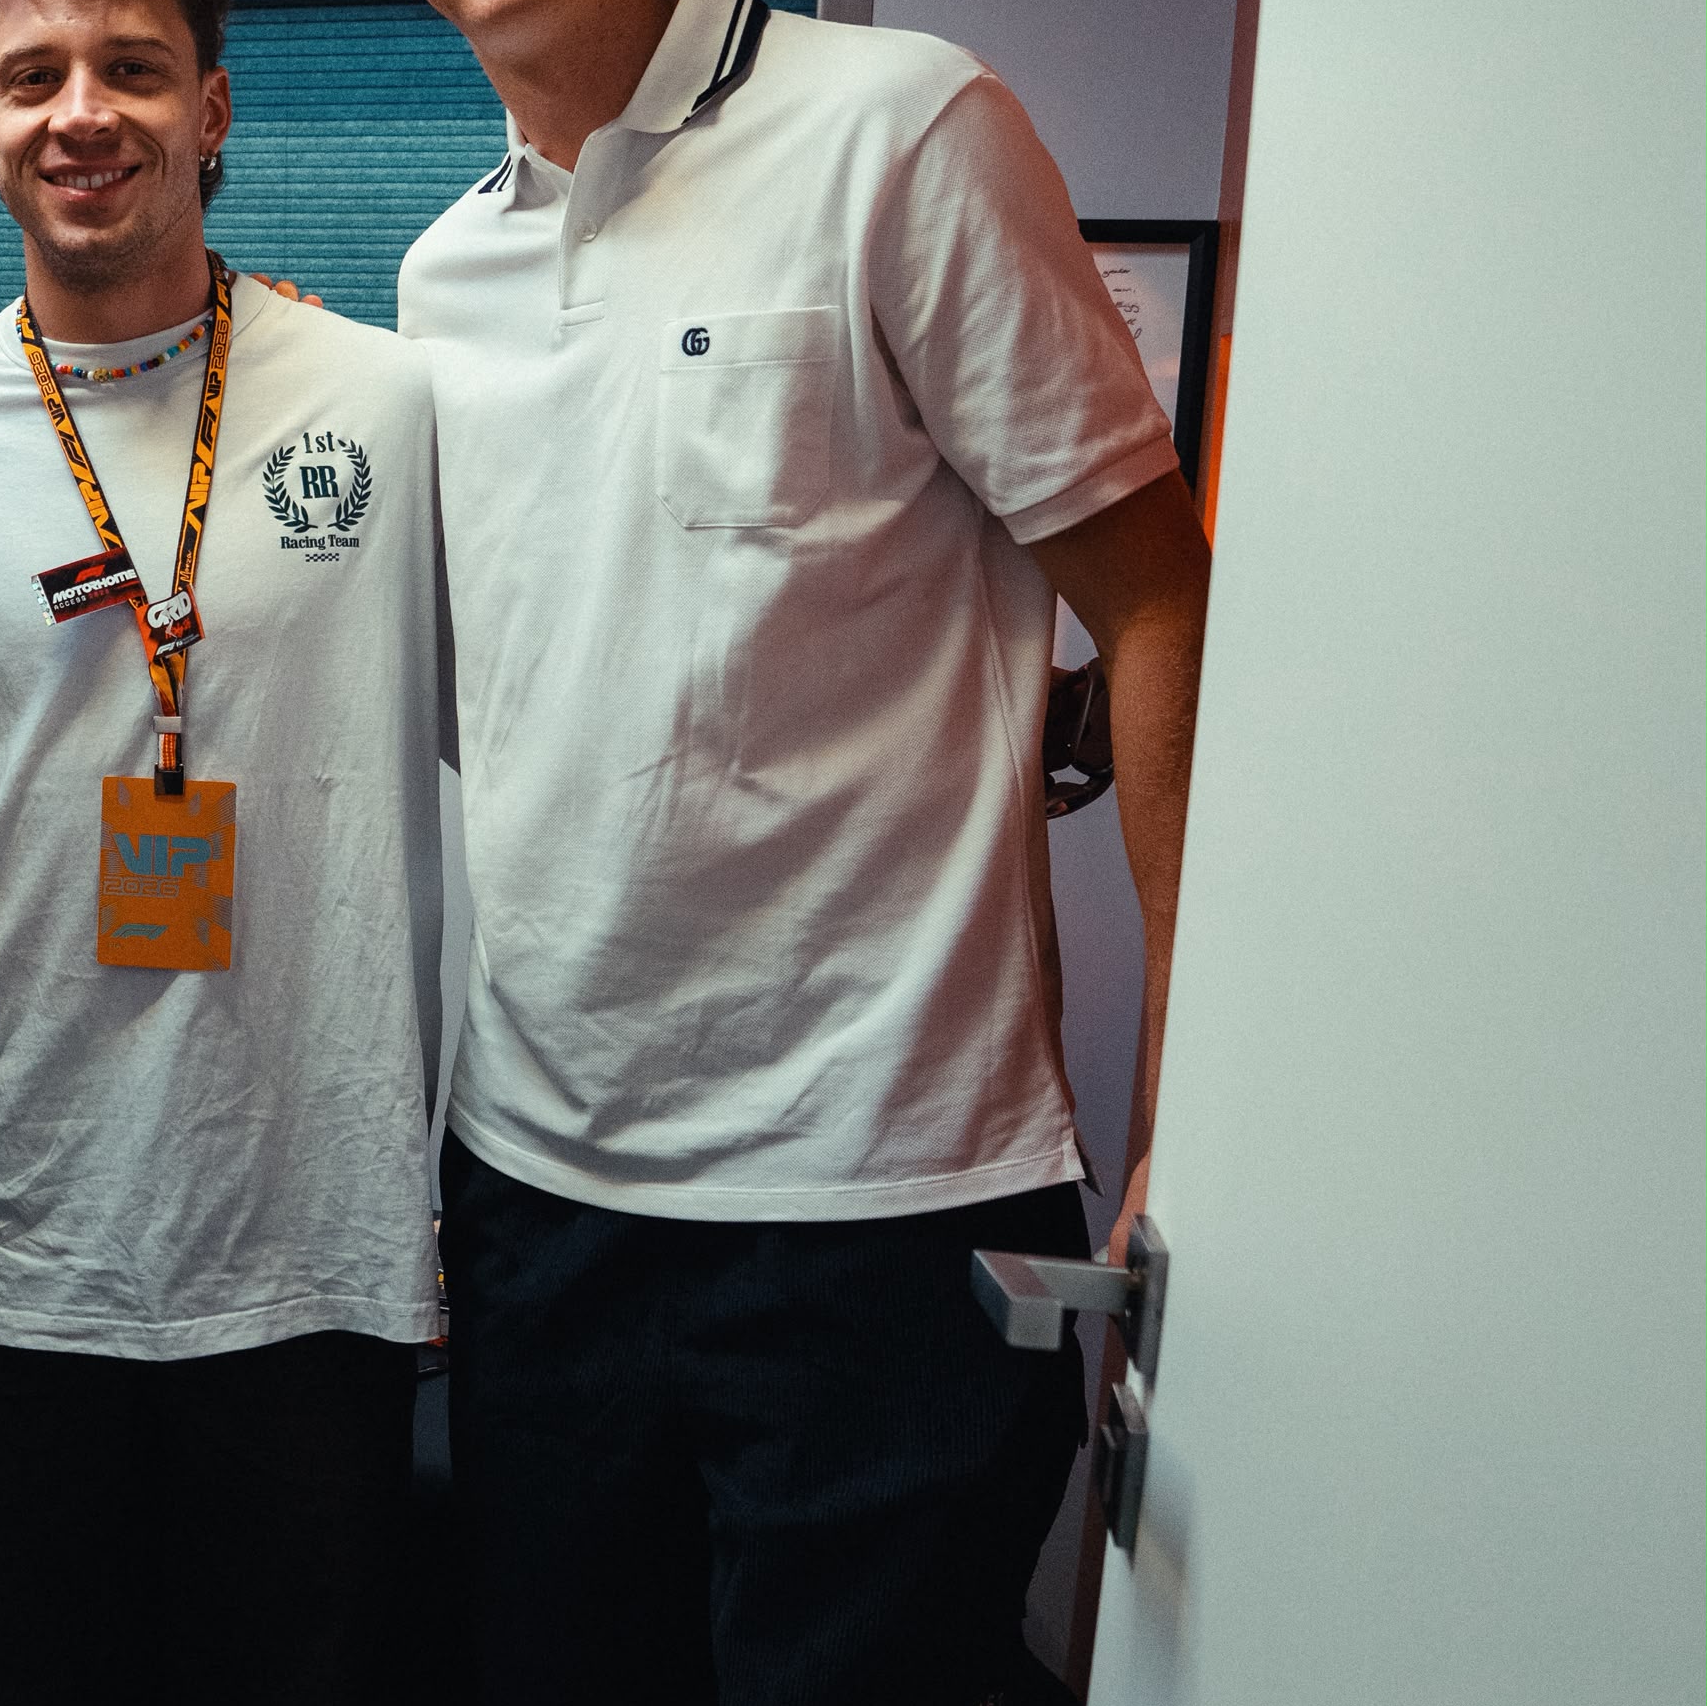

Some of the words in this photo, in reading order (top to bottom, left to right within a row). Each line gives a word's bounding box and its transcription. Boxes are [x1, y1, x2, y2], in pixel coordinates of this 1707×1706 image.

[210, 319, 229, 370] 2026
[206, 371, 222, 402] VIP
[47, 397, 66, 427] VIP
[302, 431, 335, 454] 1st
[299, 465, 340, 499] RR
[280, 535, 326, 551] Racing
[328, 534, 360, 548] Team
[52, 569, 138, 605] MOTORHOME
[54, 596, 87, 611] ACCESS
[112, 833, 212, 878] VIP
[102, 875, 180, 899] 2026
